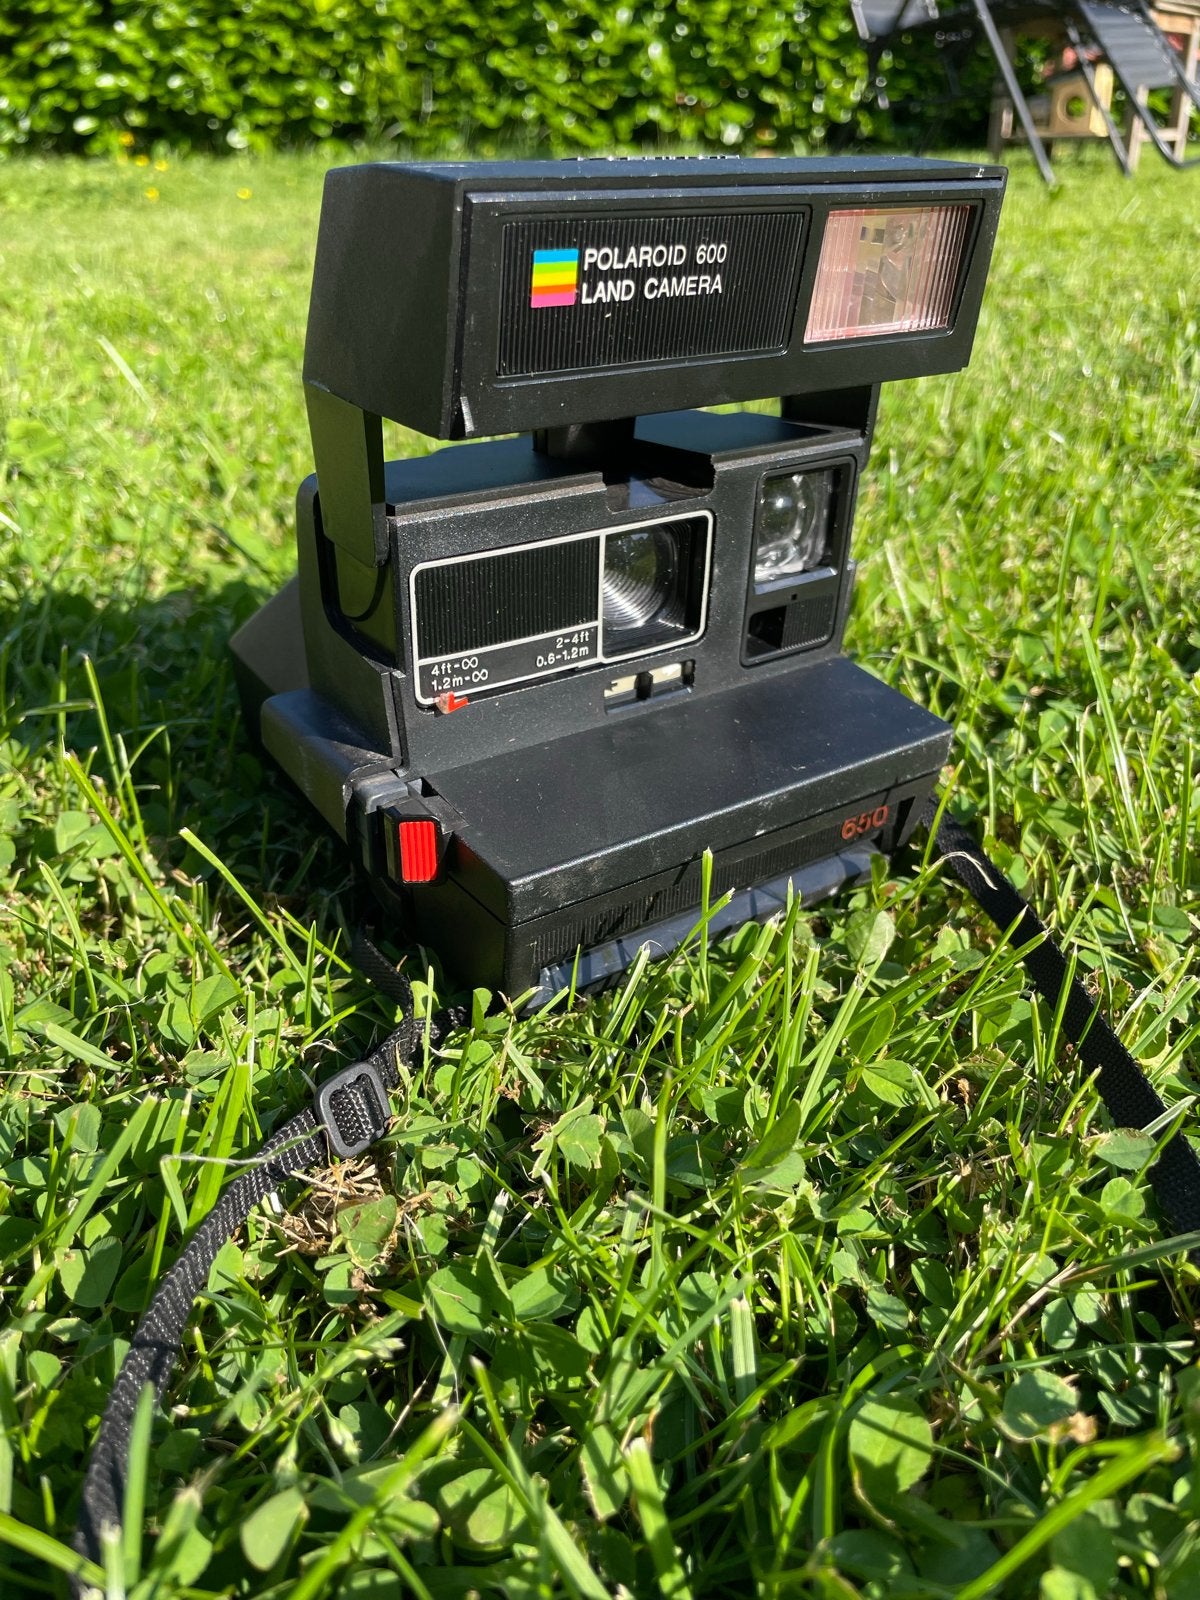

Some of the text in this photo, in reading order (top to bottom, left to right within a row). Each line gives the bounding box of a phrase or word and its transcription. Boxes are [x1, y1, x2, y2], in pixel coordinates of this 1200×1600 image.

[584, 244, 727, 271] POLAROID 600
[581, 274, 723, 305] LAND CAMERA
[556, 632, 590, 649] 2-4ft
[536, 646, 589, 668] 0.6-1.2m
